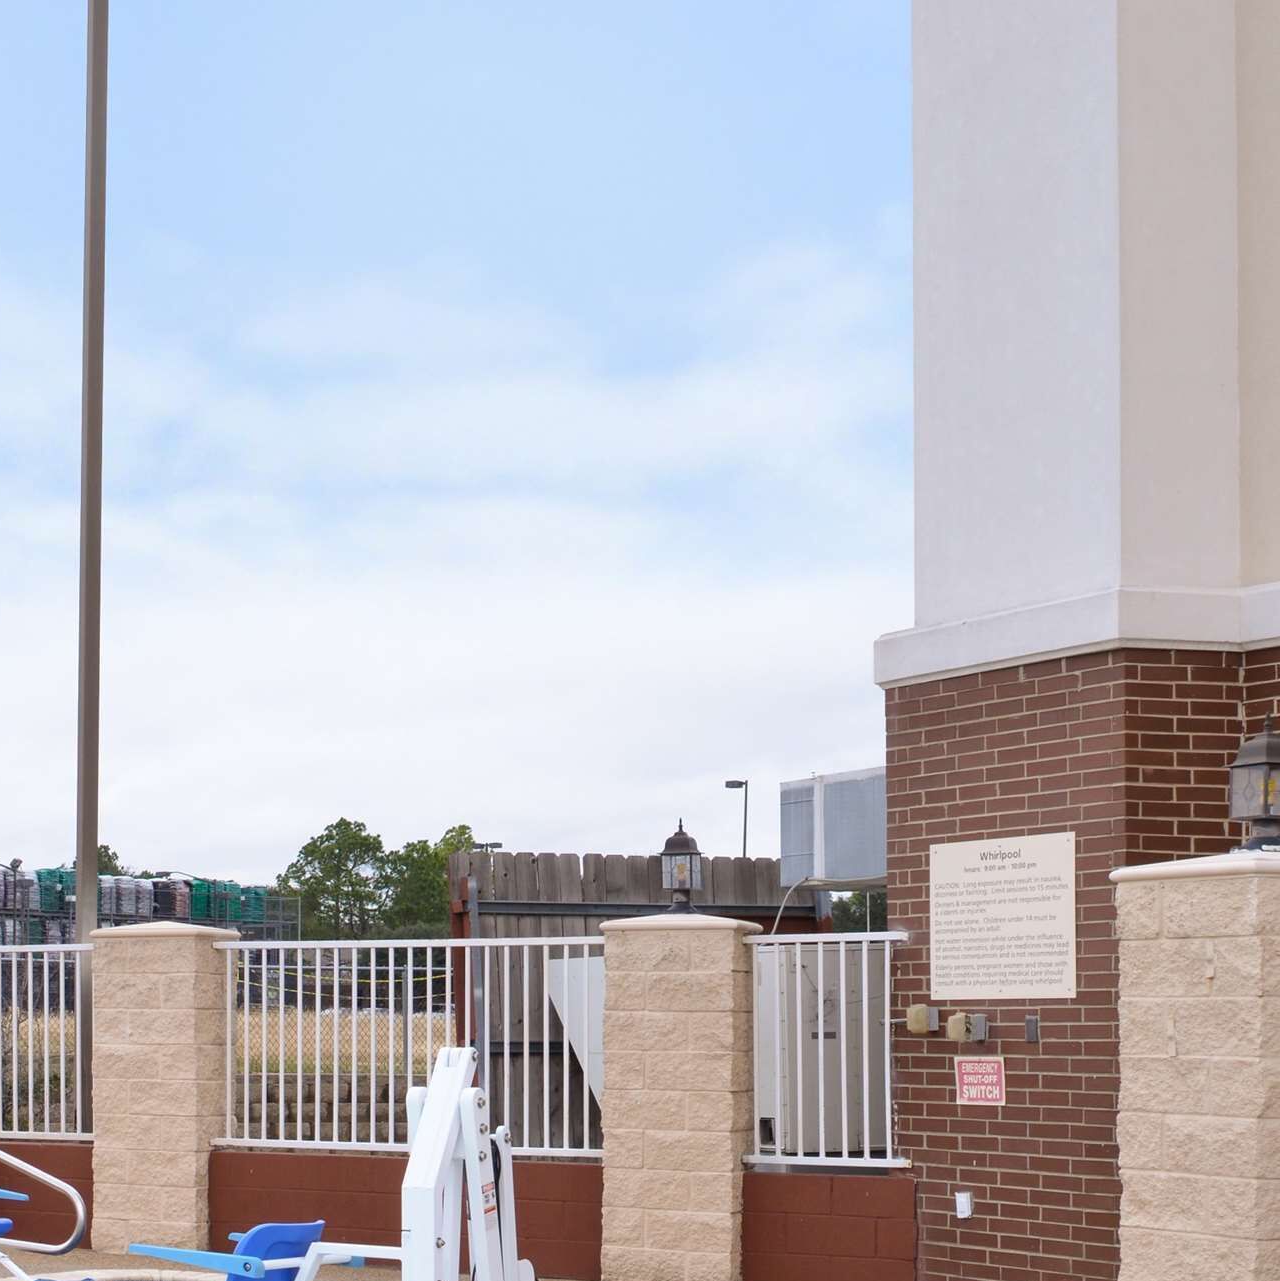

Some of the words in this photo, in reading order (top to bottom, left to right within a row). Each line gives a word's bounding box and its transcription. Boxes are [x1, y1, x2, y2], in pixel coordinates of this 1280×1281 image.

[980, 848, 1021, 863] Whirlpool
[962, 1062, 998, 1073] EMERGENCY
[963, 1074, 998, 1084] SHUT-OFF
[962, 1085, 1000, 1099] SWITCH
